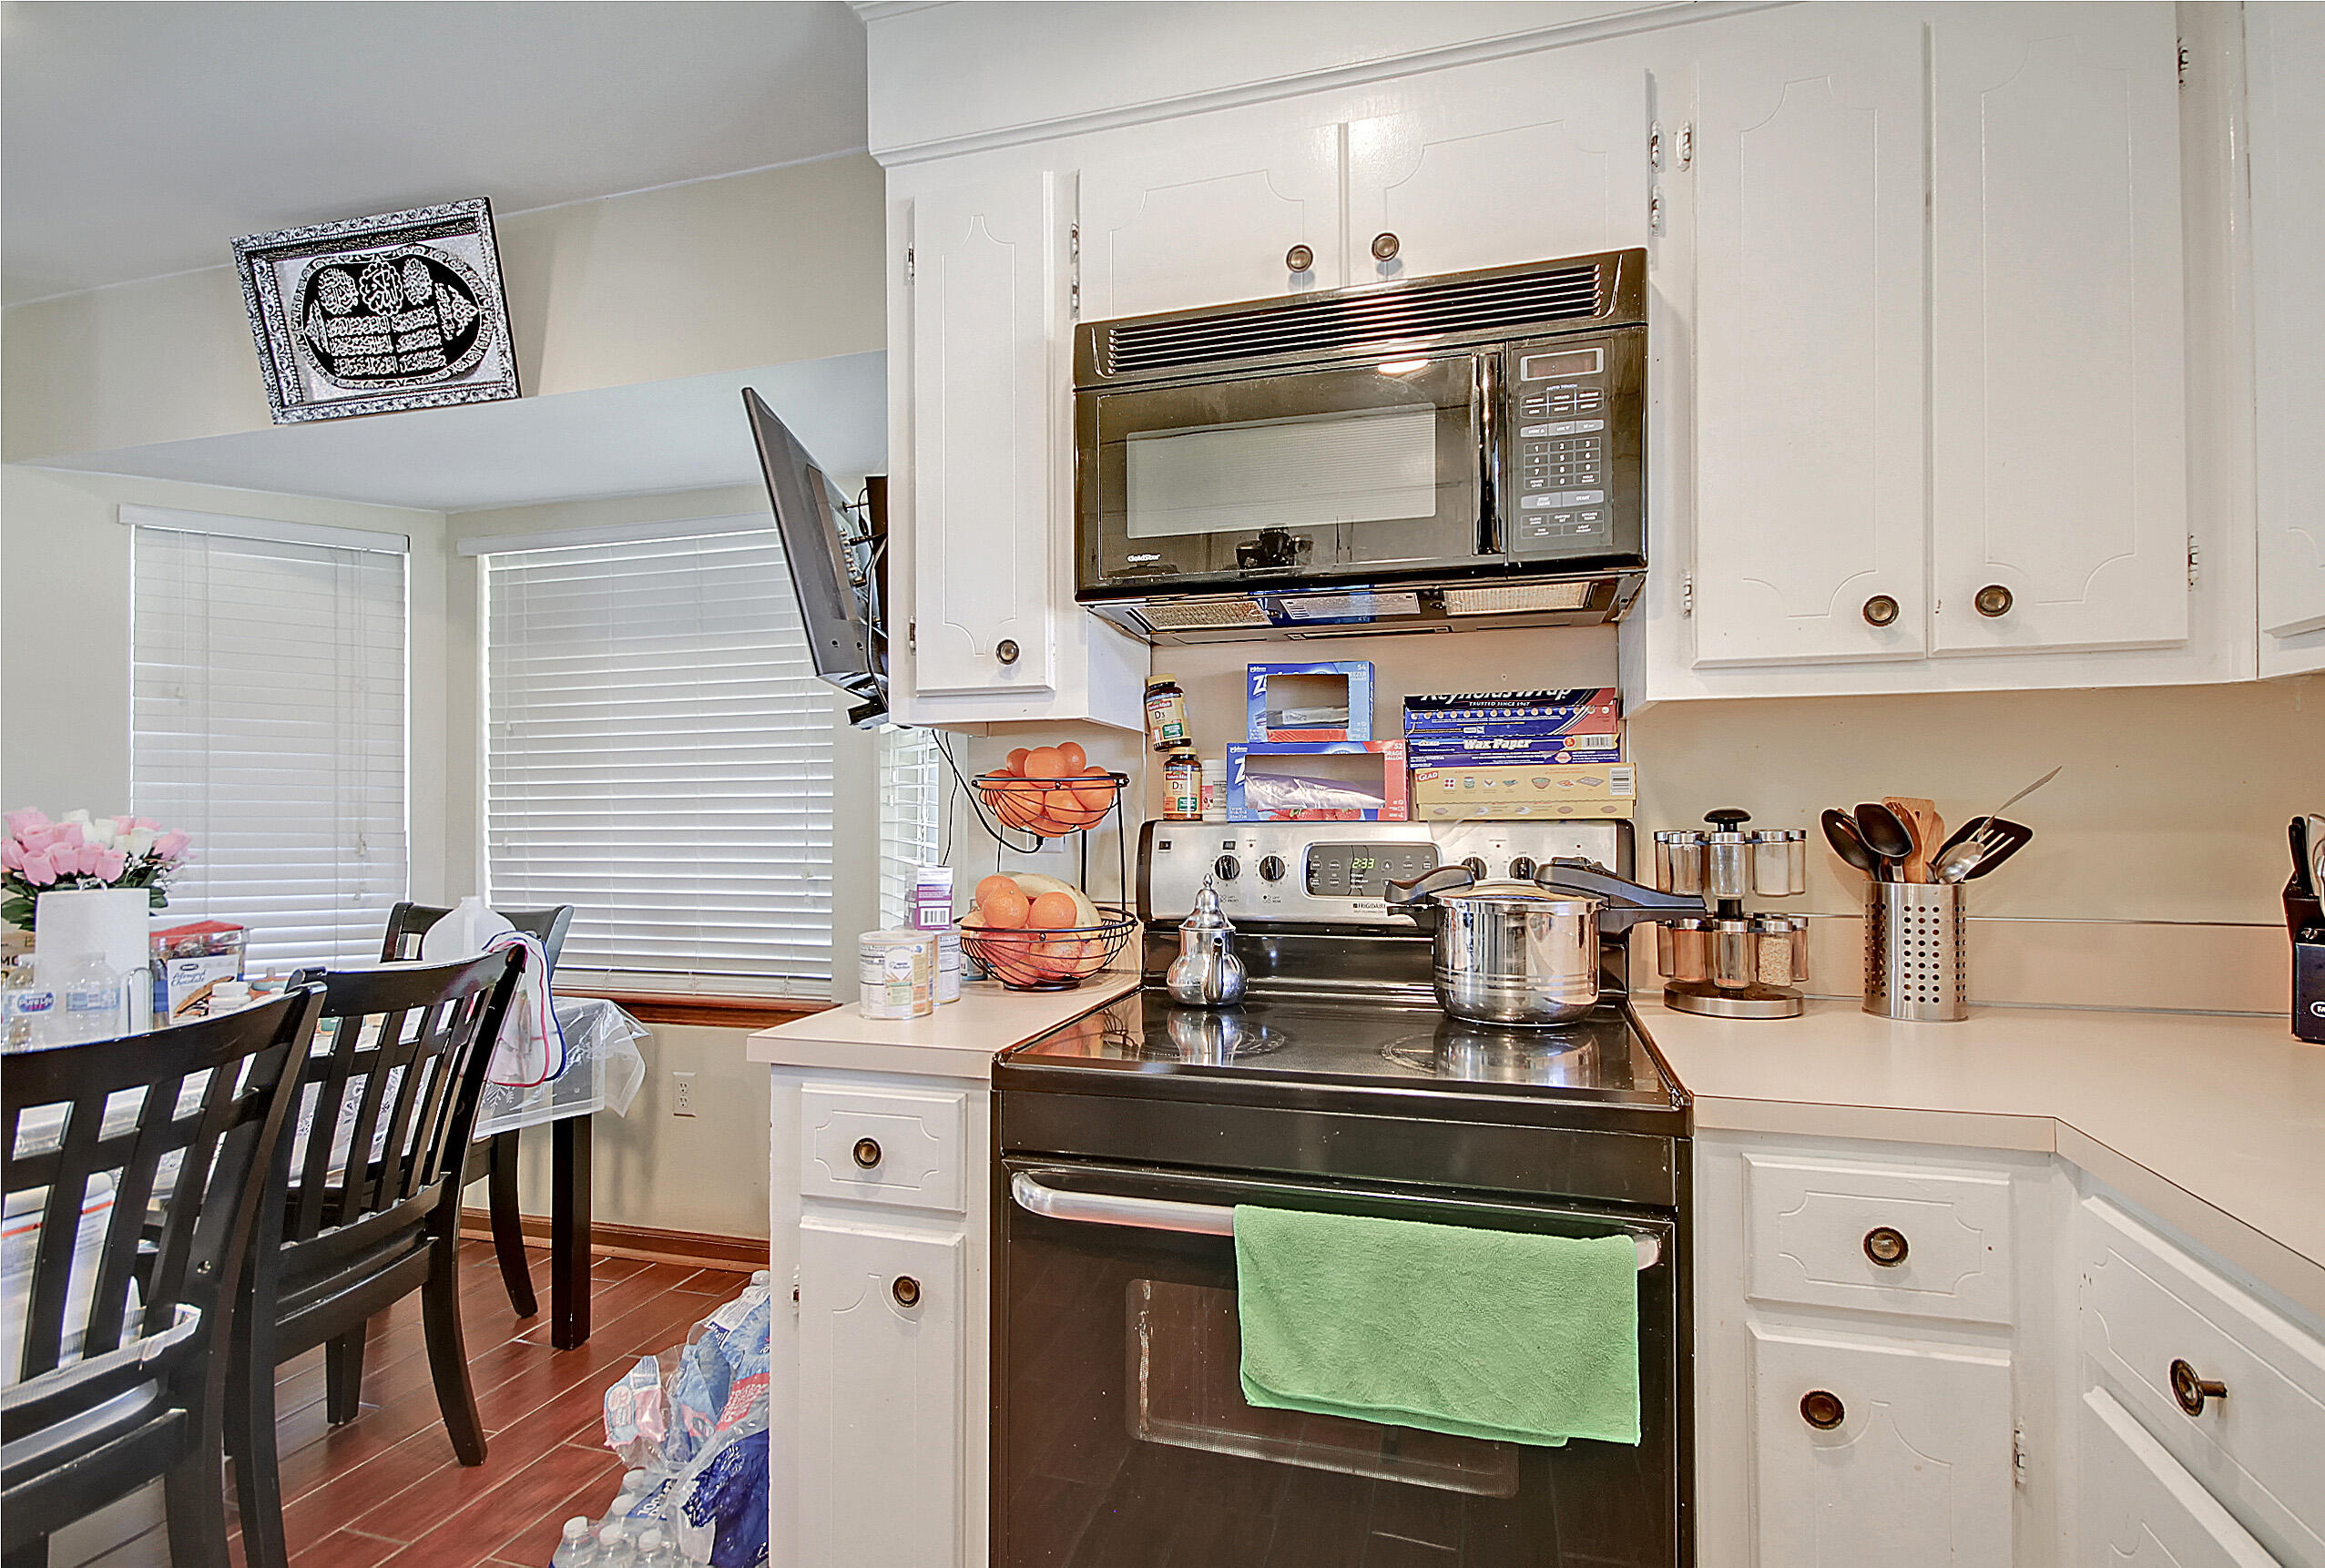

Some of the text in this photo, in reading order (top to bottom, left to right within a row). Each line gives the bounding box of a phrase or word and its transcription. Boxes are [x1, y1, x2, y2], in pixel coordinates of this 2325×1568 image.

[1127, 553, 1160, 562] GoldStar
[1463, 738, 1531, 750] Wax Paper
[1418, 771, 1438, 781] GLAD
[1172, 781, 1184, 789] D3
[1351, 858, 1375, 869] 2:33
